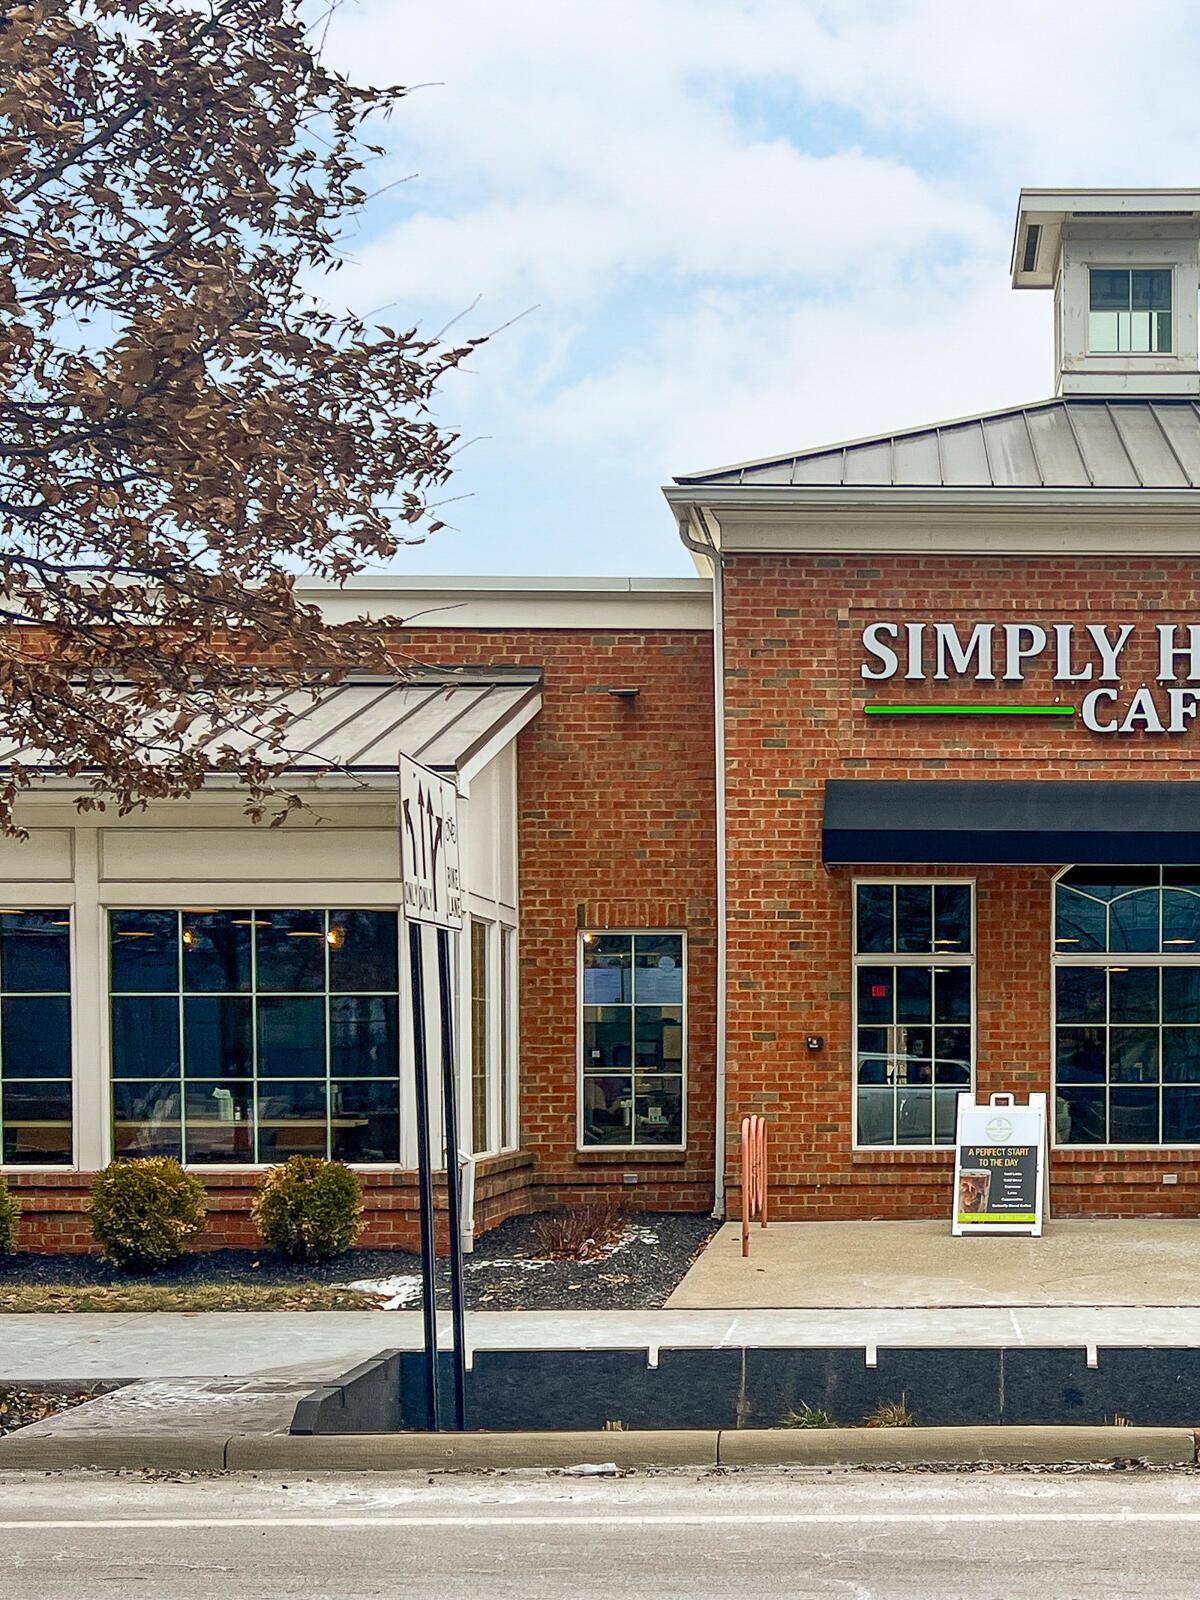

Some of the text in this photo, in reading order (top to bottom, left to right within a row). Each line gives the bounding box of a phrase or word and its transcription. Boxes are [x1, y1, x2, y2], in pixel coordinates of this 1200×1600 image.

[861, 622, 1135, 682] SIMPLY
[968, 1148, 1029, 1156] A PERFECT START
[979, 1158, 1019, 1166] TO THE DAY
